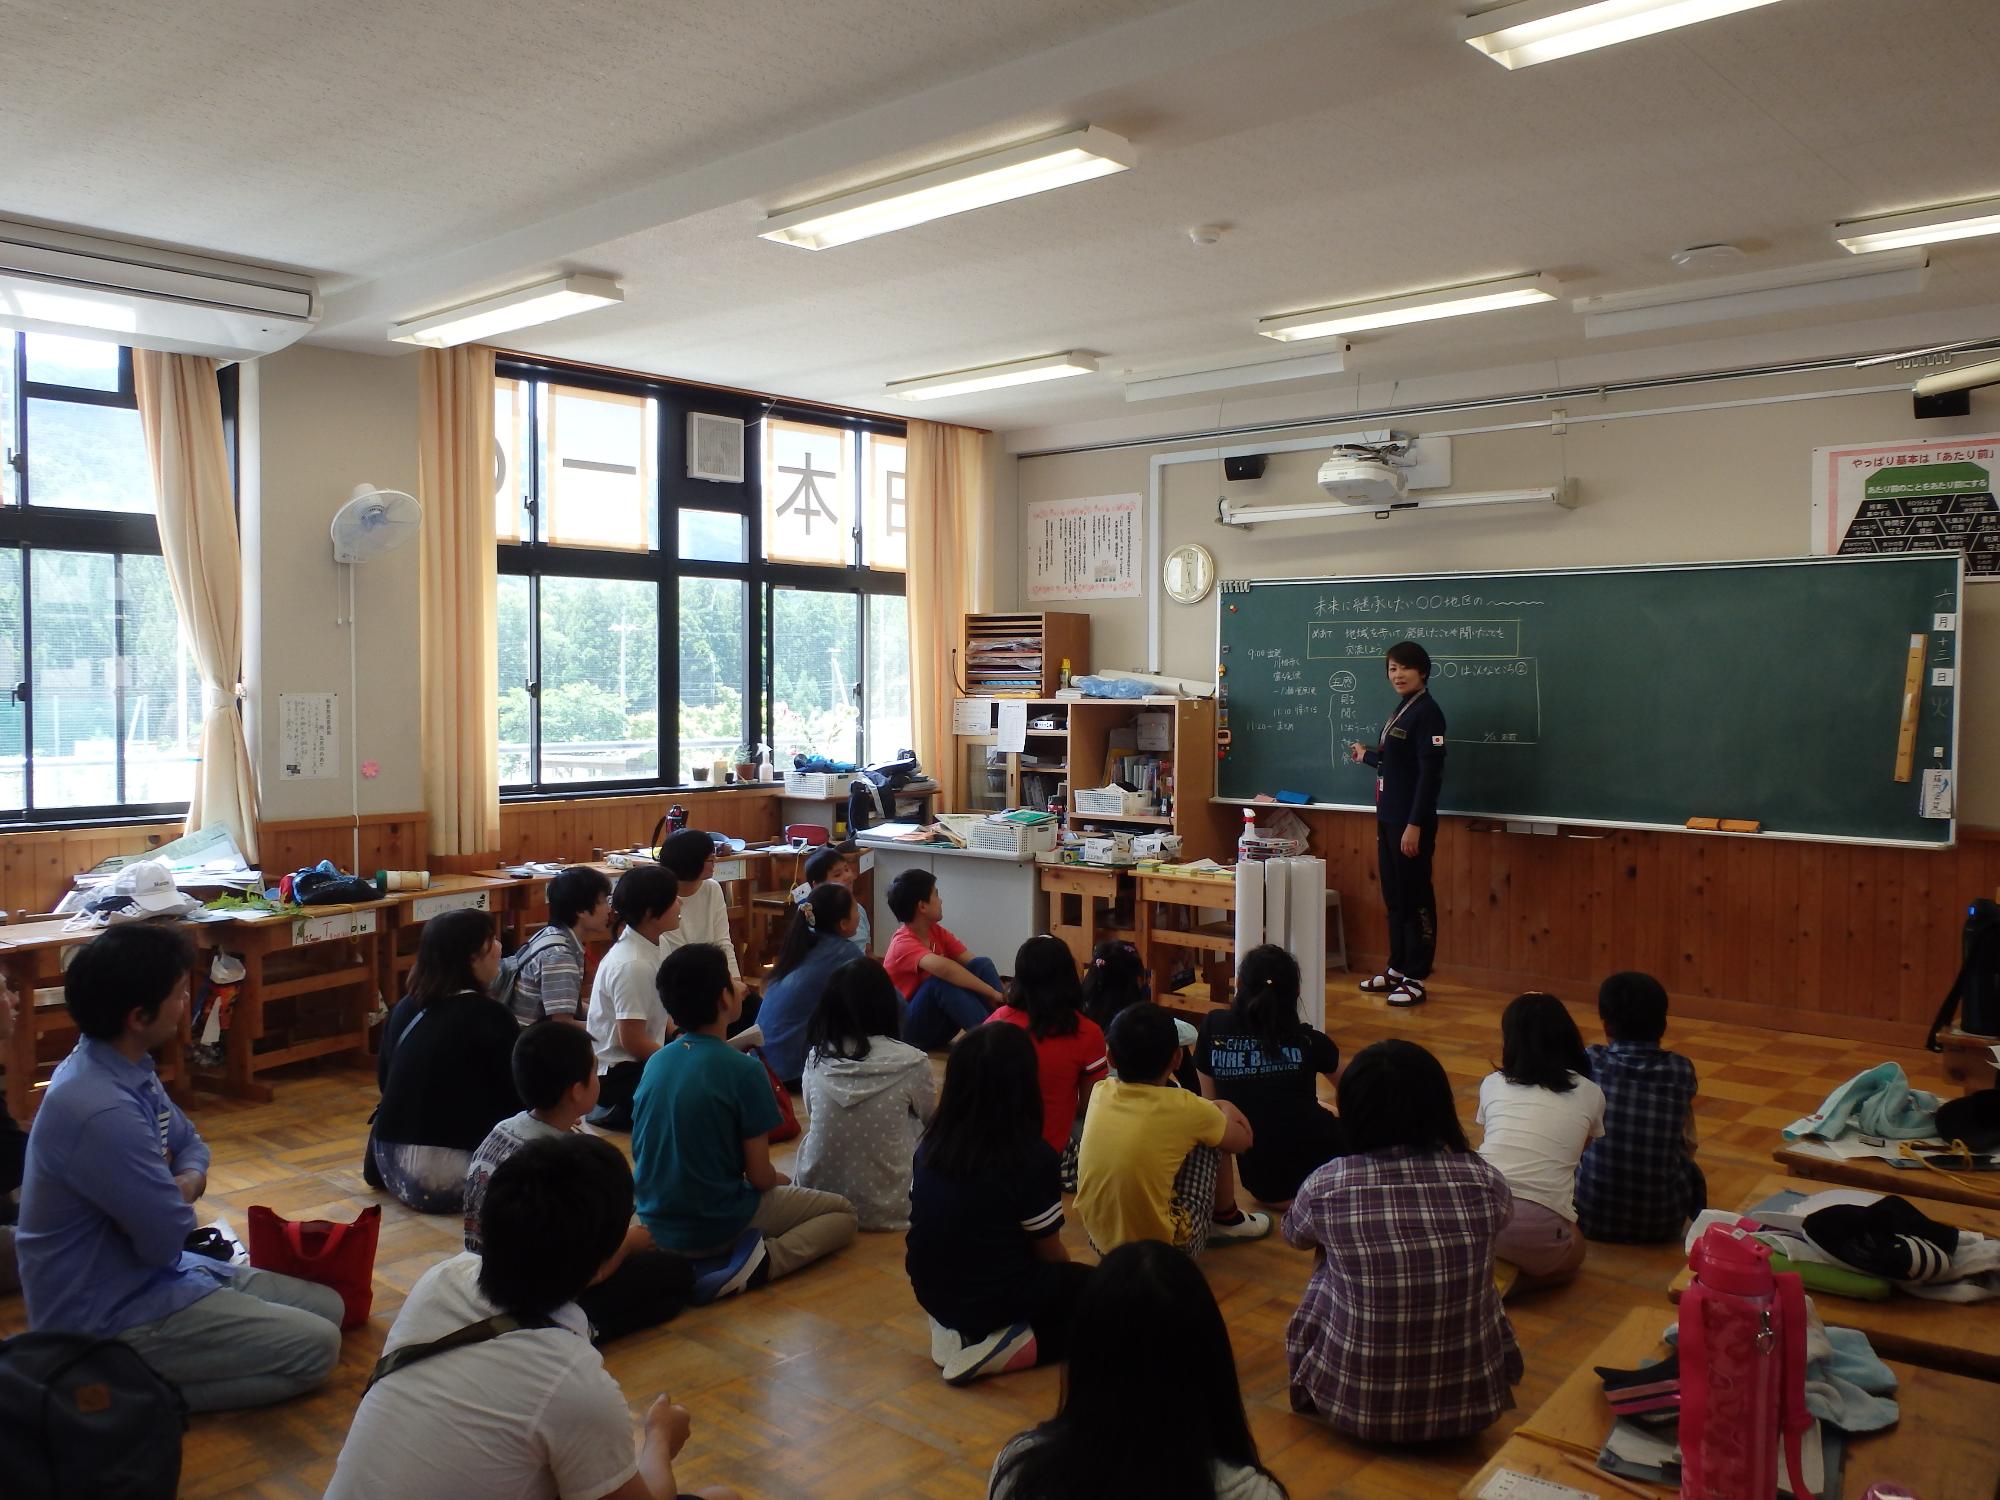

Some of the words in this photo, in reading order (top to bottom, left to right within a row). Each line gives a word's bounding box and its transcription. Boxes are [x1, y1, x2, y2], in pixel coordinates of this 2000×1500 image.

[1852, 449, 1994, 468] やっぱり基本は「あたり前」
[1867, 479, 1987, 494] あたり前のことをあたり前にする
[1211, 1048, 1245, 1068] PURE
